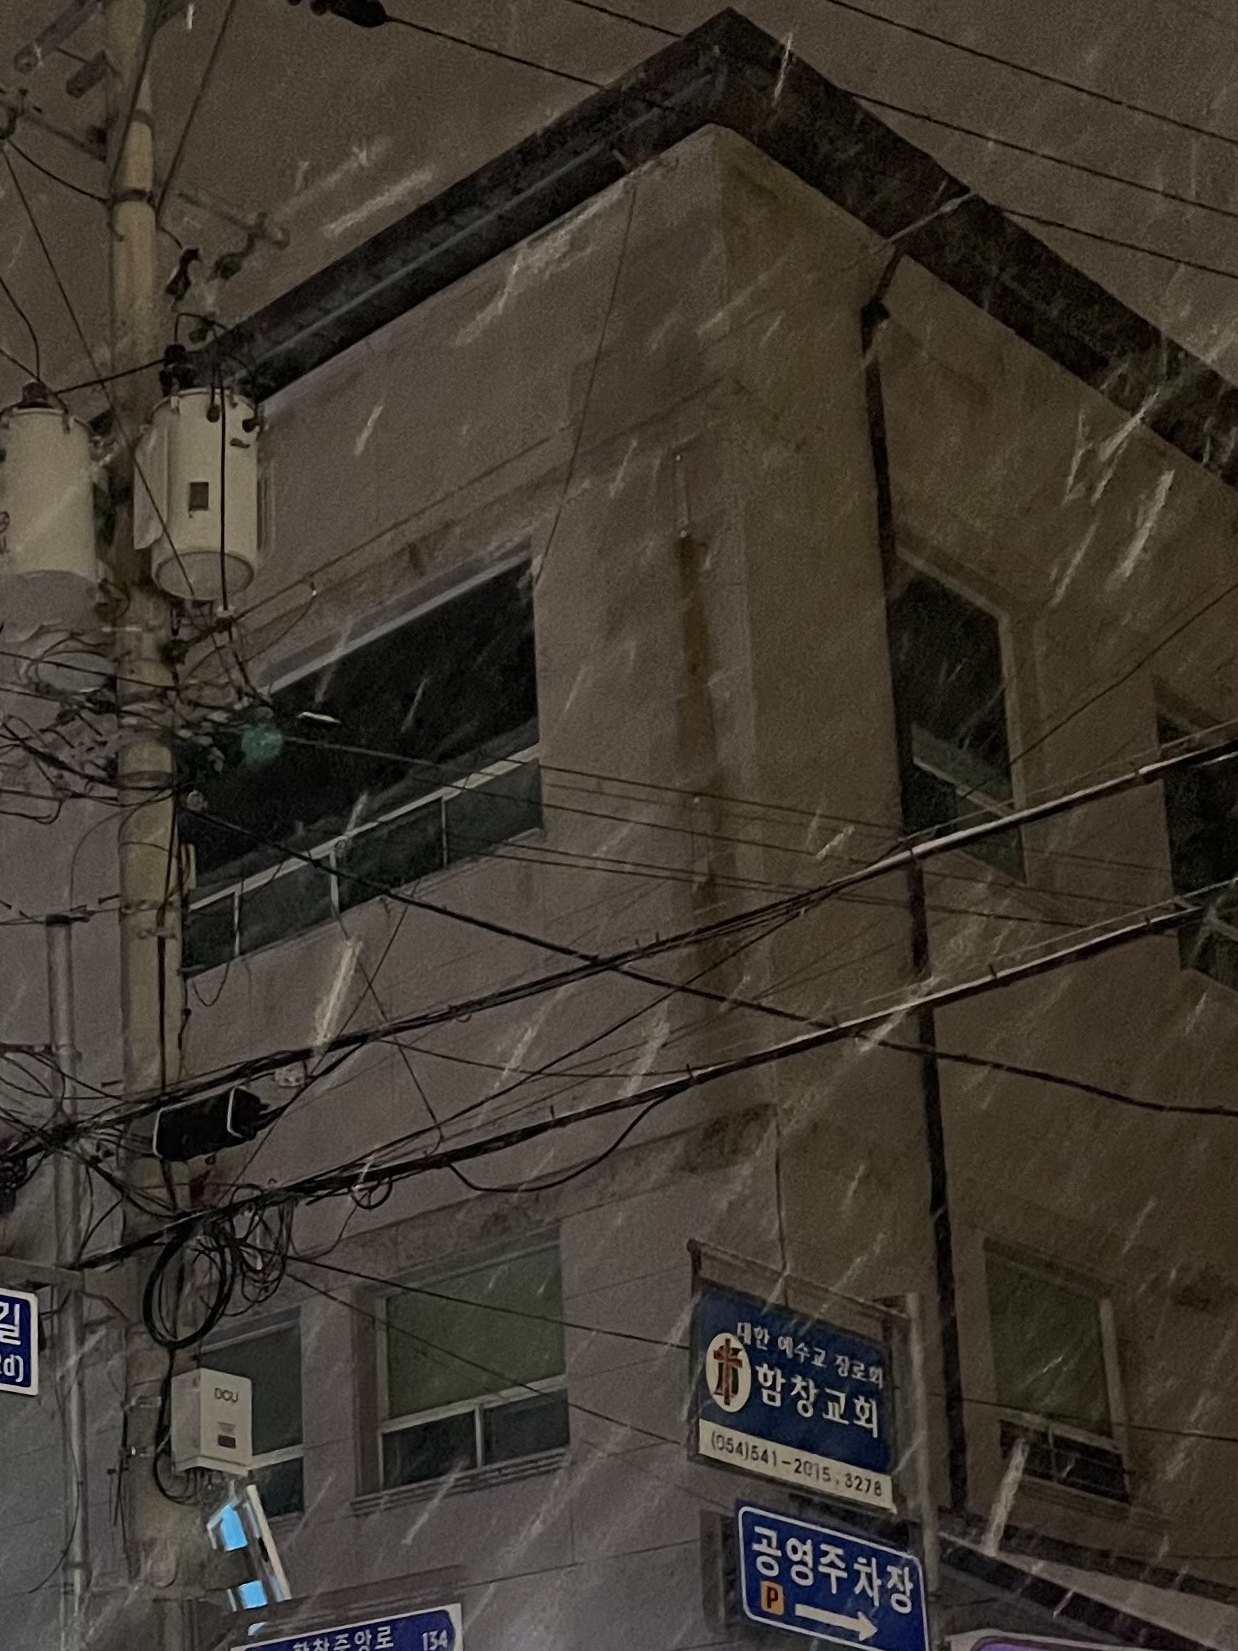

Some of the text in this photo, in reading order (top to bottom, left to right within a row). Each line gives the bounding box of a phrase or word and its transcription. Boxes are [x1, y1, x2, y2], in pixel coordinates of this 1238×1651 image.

[736, 1322, 770, 1350] 대한
[834, 1354, 884, 1389] 장로회
[755, 1362, 878, 1439] 함창교회
[751, 1526, 914, 1615] 공영주차장
[768, 1587, 780, 1611] P
[422, 1629, 449, 1651] 134
